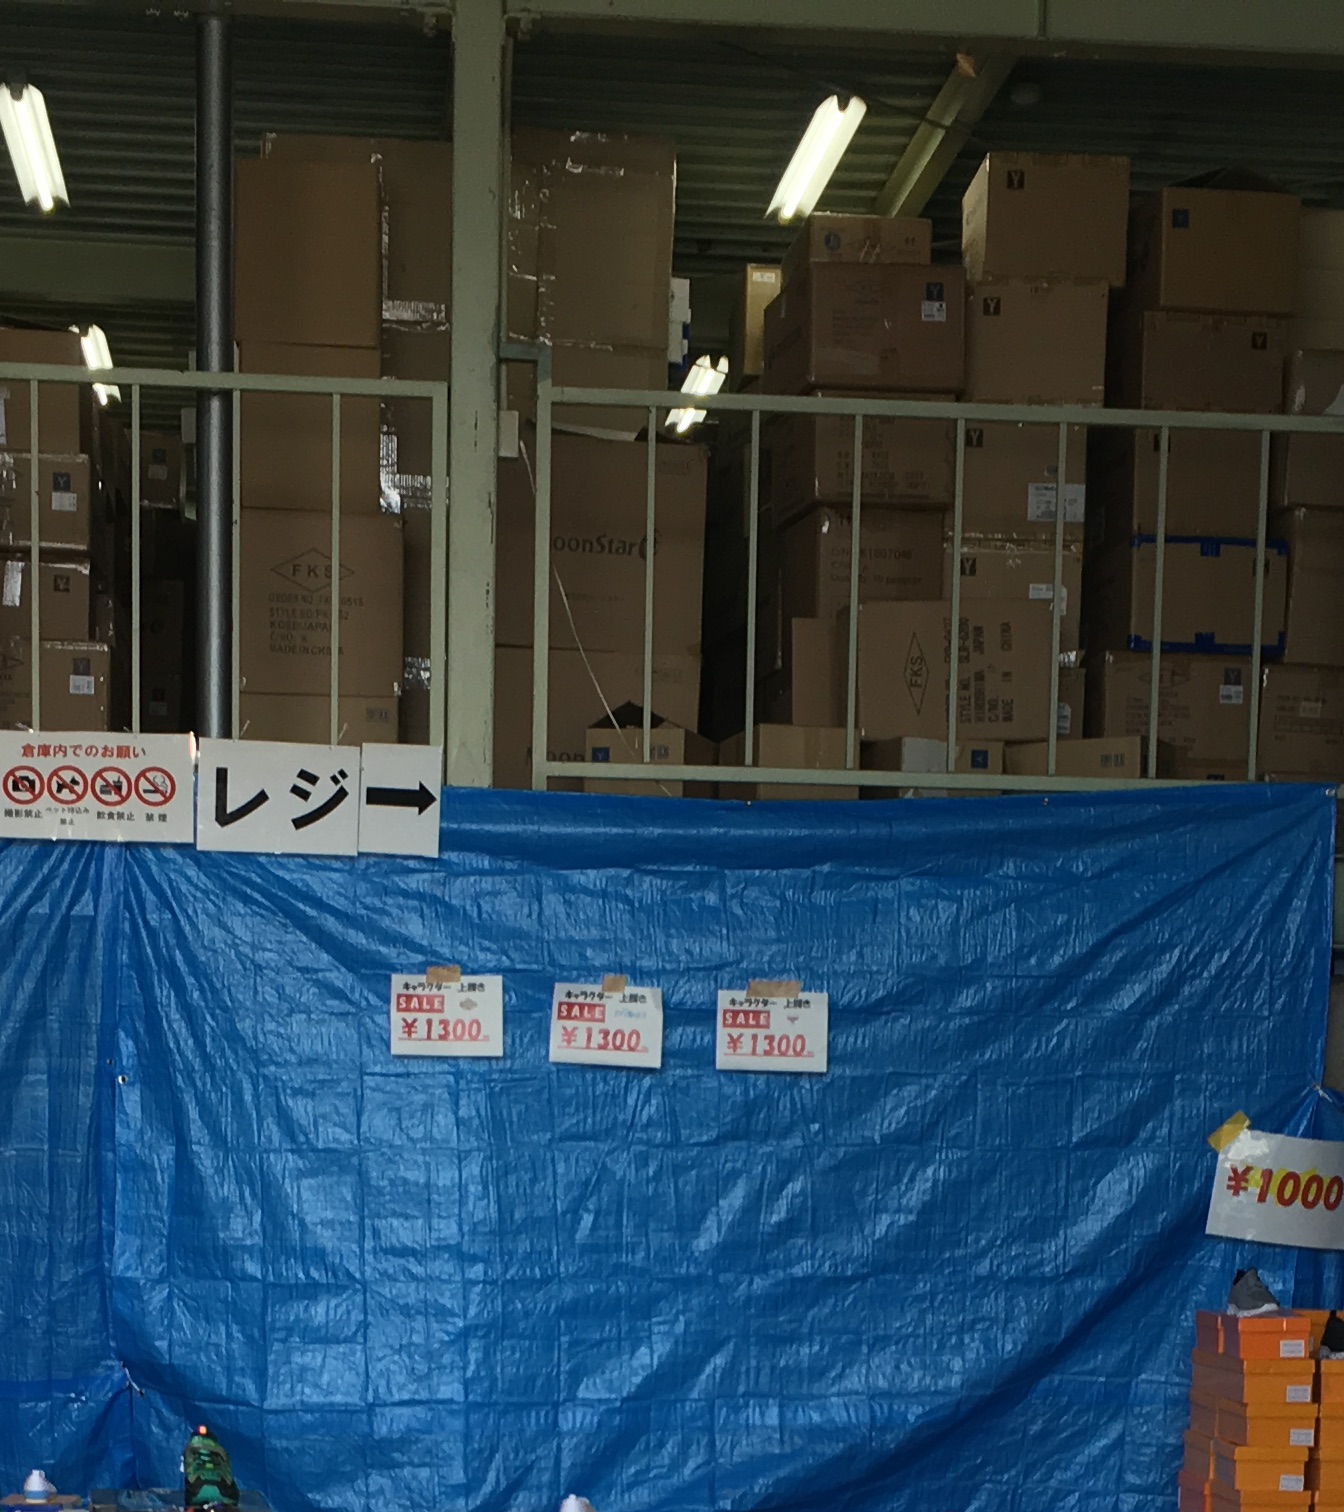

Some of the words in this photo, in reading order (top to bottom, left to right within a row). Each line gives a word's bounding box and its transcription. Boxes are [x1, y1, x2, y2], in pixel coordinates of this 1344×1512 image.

[550, 533, 637, 557] oonStar
[21, 743, 146, 759] 倉庫内でのお願い
[214, 765, 350, 831] レジ
[398, 995, 443, 1011] SALE
[559, 1004, 604, 1020] SALE
[401, 1017, 483, 1042] ¥1300
[725, 1011, 769, 1026] SALE
[561, 1027, 642, 1052] ¥1300
[726, 1033, 807, 1057] ¥1300
[1226, 1165, 1344, 1212] ¥1000
